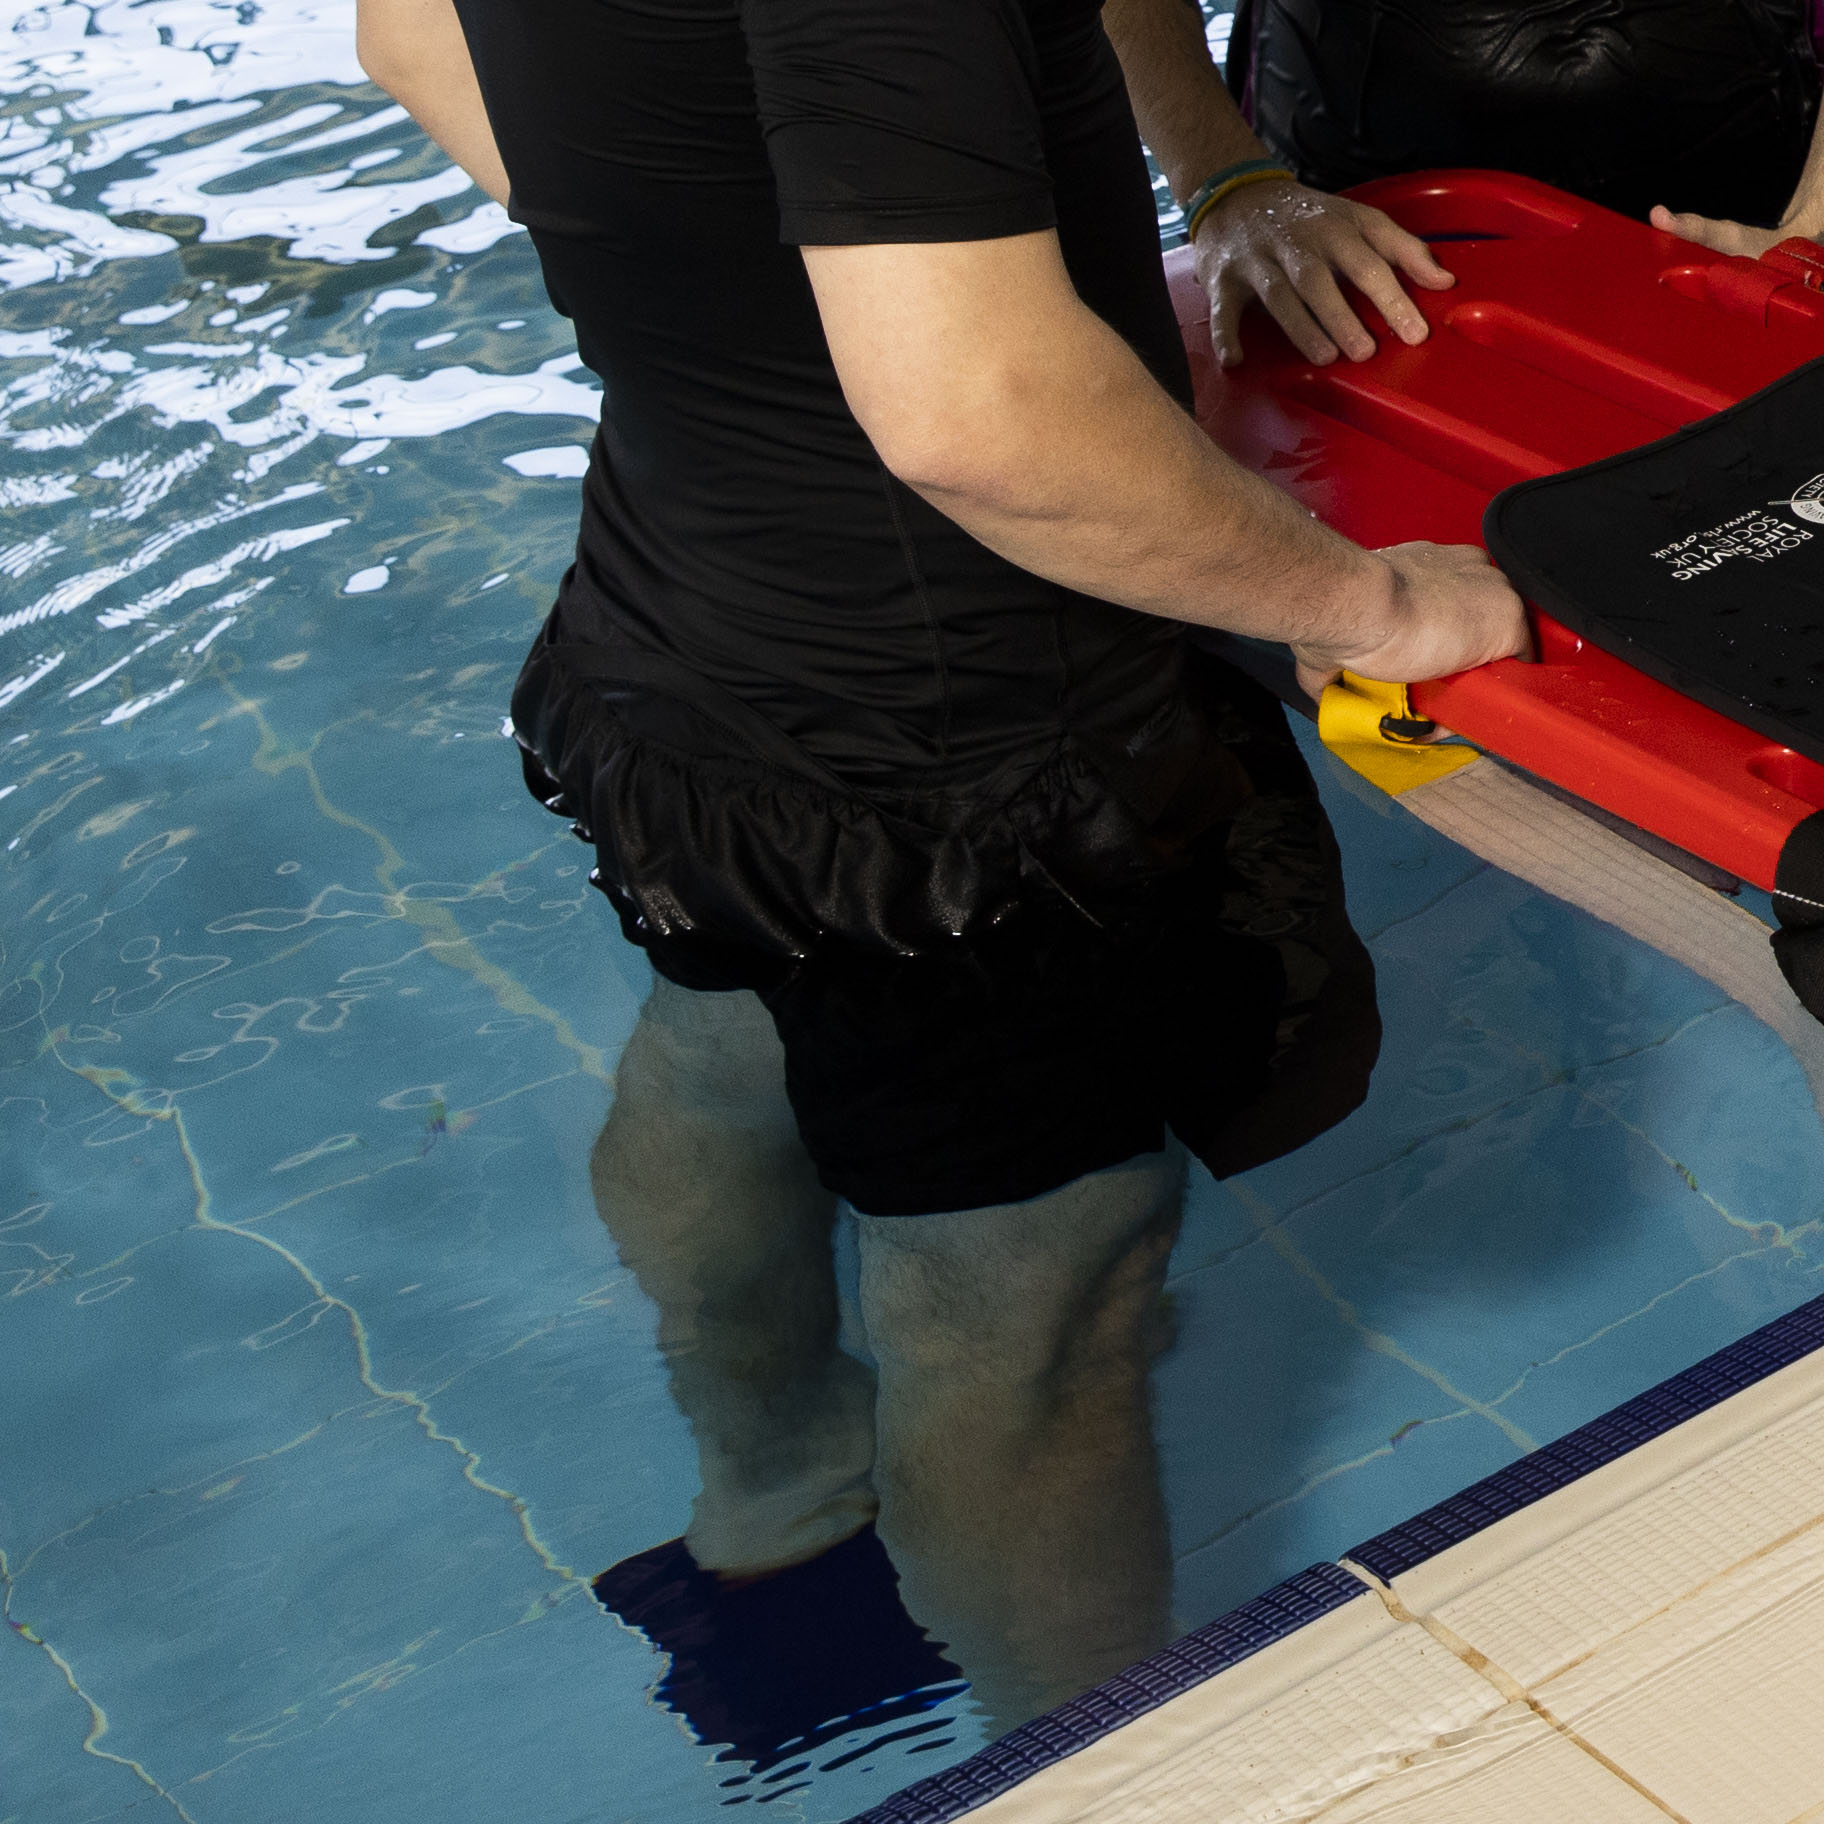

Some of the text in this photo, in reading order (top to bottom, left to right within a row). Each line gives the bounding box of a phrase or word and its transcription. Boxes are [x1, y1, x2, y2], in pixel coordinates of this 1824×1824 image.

[1666, 515, 1779, 568] SOCIETY UK
[1672, 522, 1797, 580] LIFE SAVING
[1747, 530, 1813, 562] ROYAL
